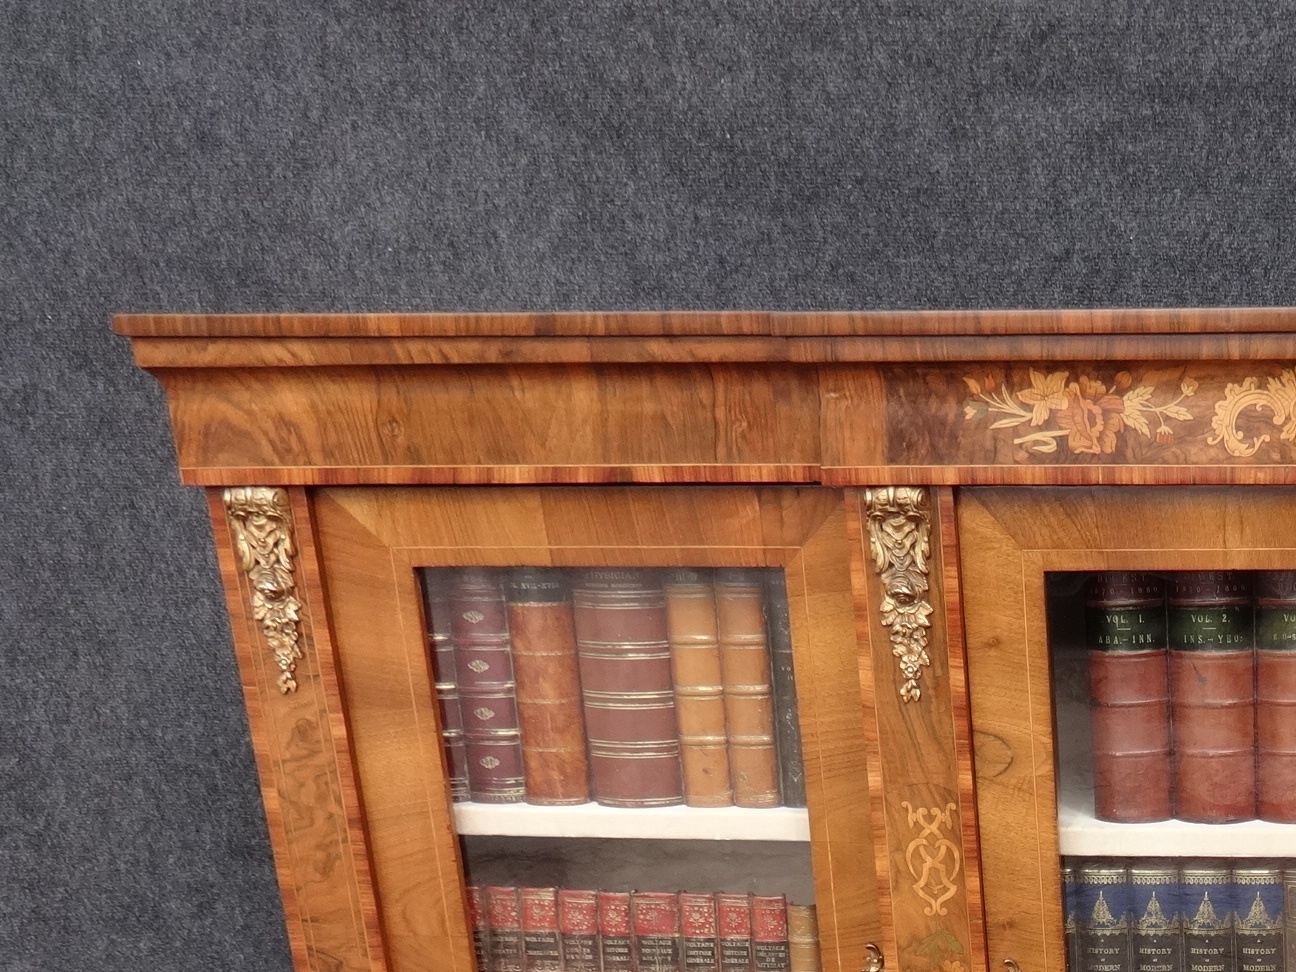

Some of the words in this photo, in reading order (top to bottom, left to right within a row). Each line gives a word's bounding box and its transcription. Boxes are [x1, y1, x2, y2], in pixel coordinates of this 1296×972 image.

[1191, 614, 1213, 623] VOL.
[1222, 614, 1231, 623] 2.
[1139, 947, 1173, 955] HISTORY
[1190, 947, 1225, 955] HISTORY
[1242, 947, 1276, 955] HISTORY
[1087, 964, 1121, 972] MODERN
[1139, 964, 1173, 972] MODERN
[1191, 964, 1225, 972] MODERN
[1242, 964, 1276, 972] MODERN
